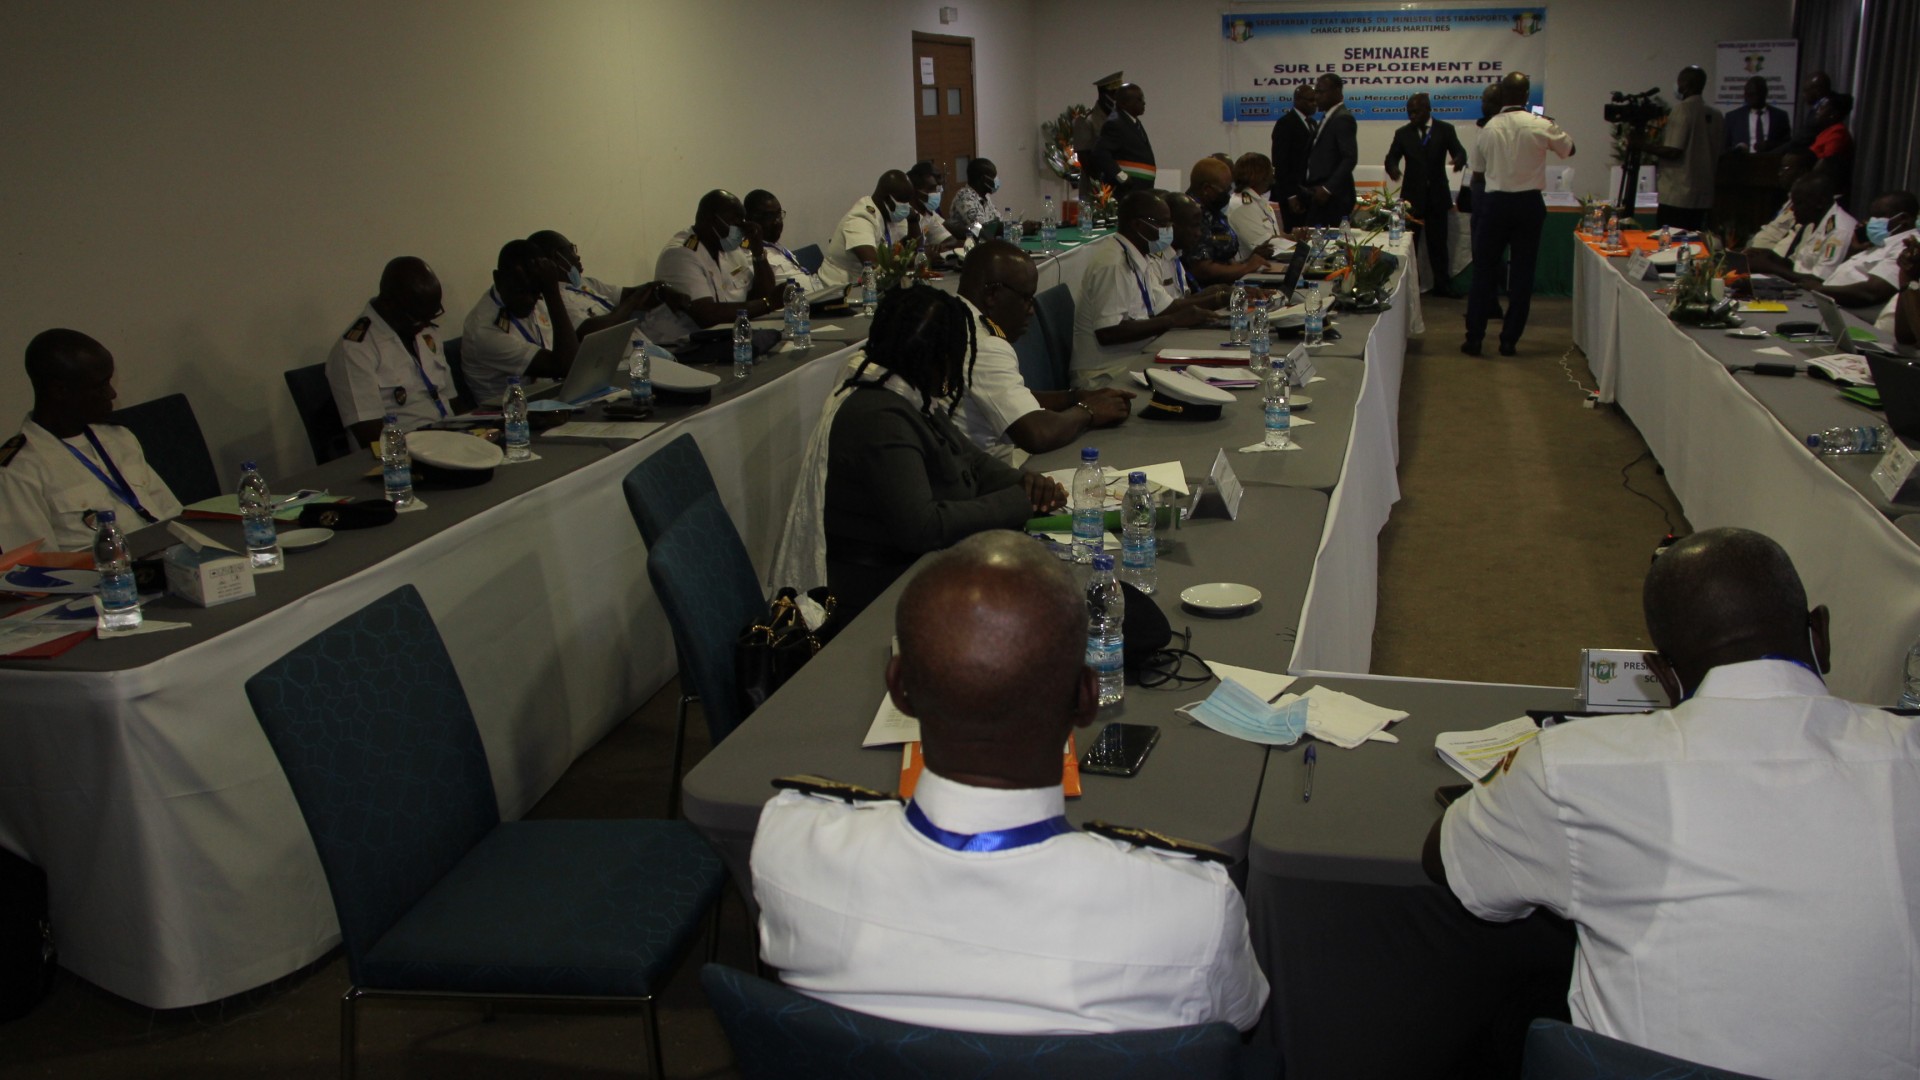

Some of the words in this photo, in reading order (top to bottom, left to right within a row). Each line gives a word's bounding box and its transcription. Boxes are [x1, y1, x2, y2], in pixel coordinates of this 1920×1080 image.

[1310, 26, 1344, 34] CHARGE
[1362, 25, 1401, 33] AFFAIRES
[1344, 47, 1429, 60] SEMINAIRE
[1273, 64, 1310, 73] SUR
[1316, 63, 1336, 73] LE
[1342, 62, 1473, 73] DEPLOIEMENT
[1478, 61, 1503, 71] DE
[1253, 76, 1429, 86] L'ADMISTRATION
